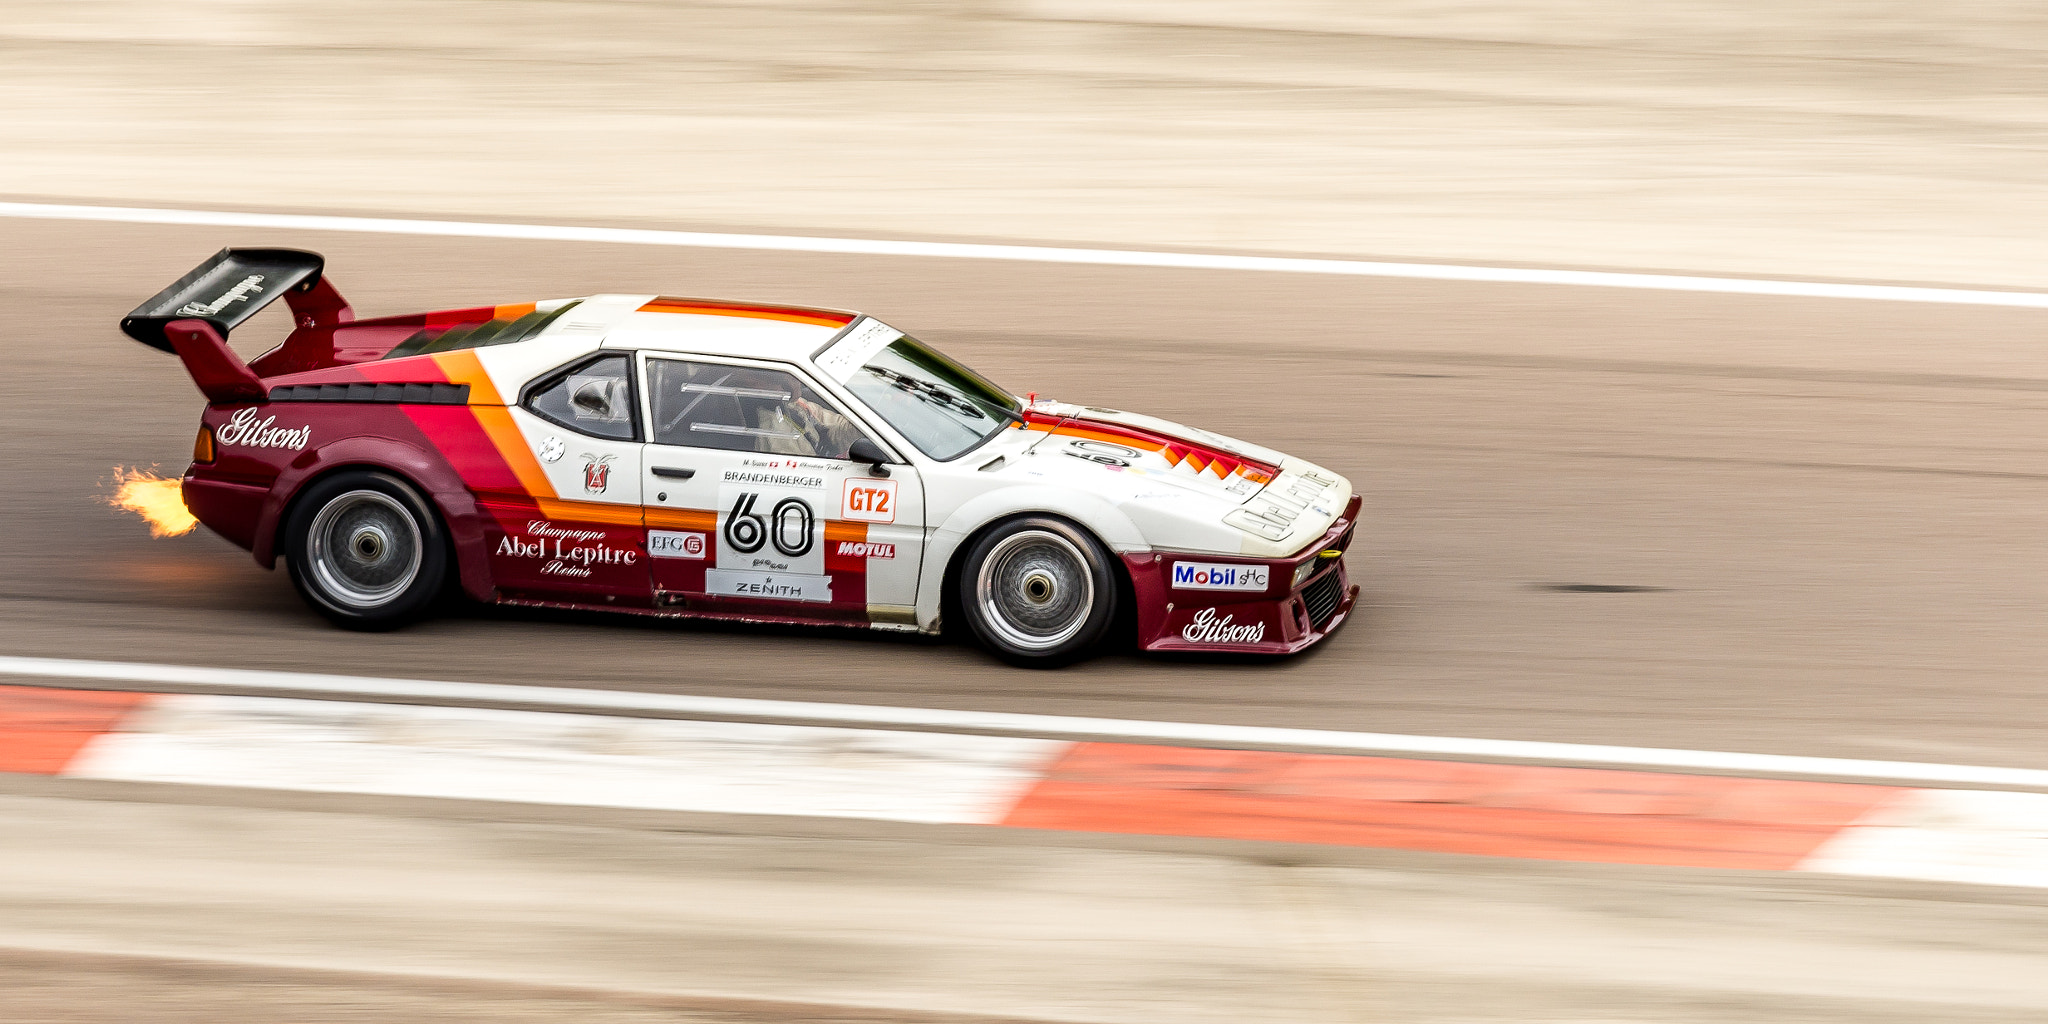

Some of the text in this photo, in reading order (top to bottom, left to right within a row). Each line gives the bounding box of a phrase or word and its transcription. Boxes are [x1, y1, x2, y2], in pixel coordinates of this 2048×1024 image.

[216, 406, 311, 451] Gibson's
[724, 471, 823, 487] BRANDENBERGER
[849, 486, 890, 513] GT2
[526, 519, 607, 544] Champagne
[724, 491, 815, 557] 60
[495, 534, 637, 566] Abel Lepitre
[651, 535, 683, 551] EFG
[837, 541, 894, 558] MOTUL
[1175, 565, 1236, 586] Mobil
[736, 582, 802, 597] ZENITH
[1182, 606, 1266, 644] Gibson's
